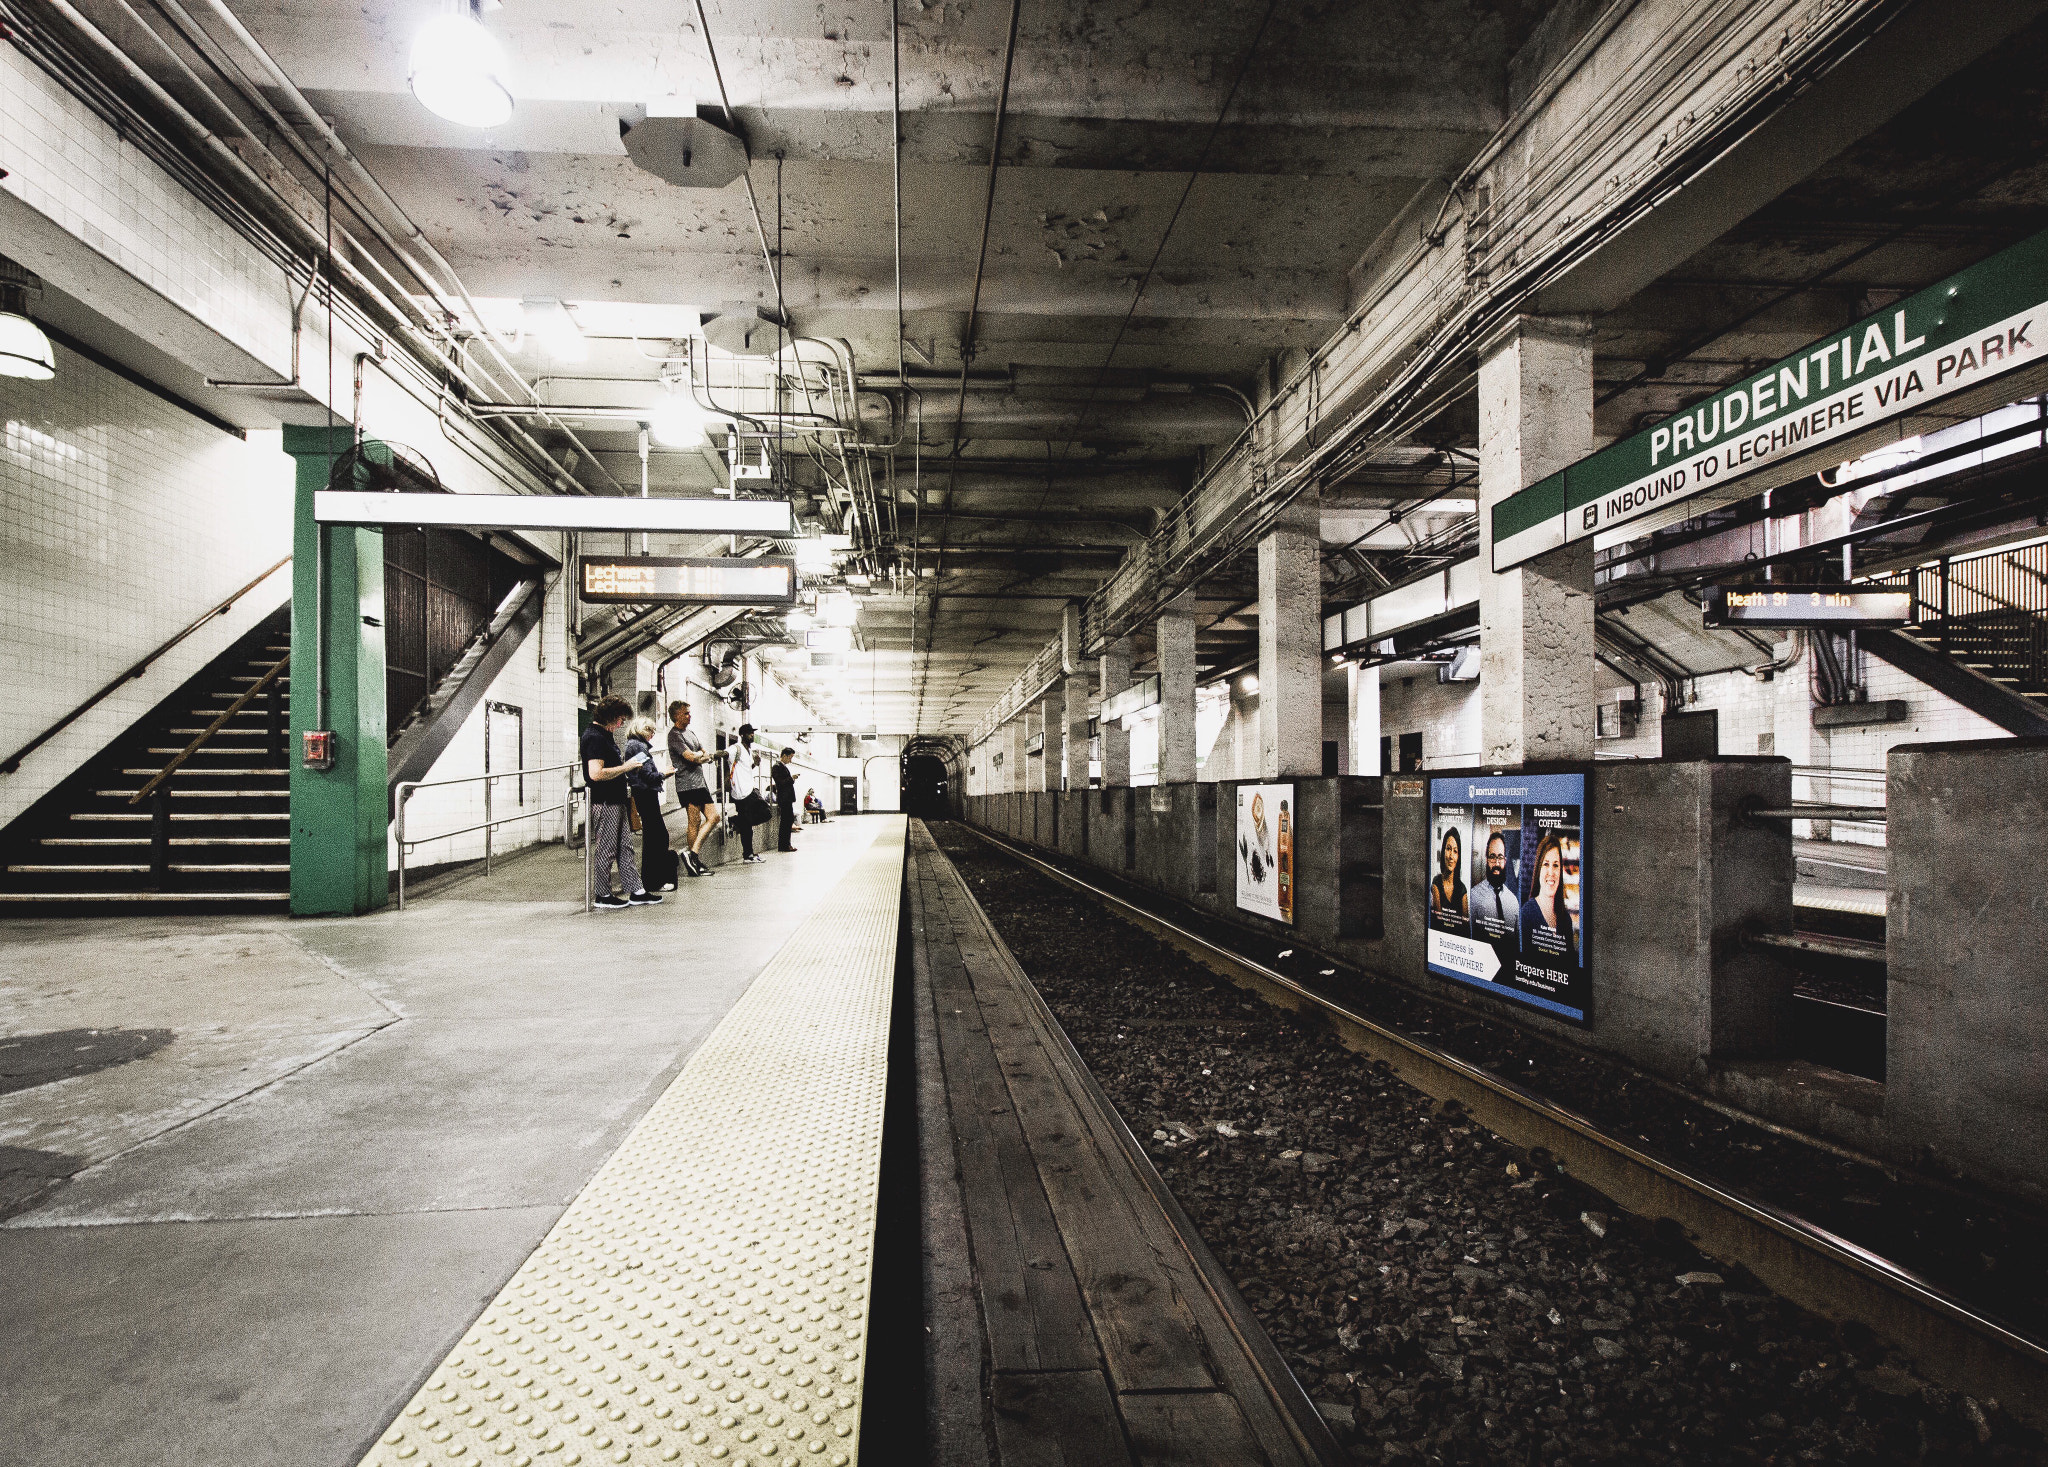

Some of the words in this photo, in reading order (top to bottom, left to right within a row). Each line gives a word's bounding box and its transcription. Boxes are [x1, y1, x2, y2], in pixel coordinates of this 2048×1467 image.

[1650, 309, 1925, 467] PRUDENTIAL
[1605, 467, 1687, 520] INBOUND
[1693, 458, 1719, 484] TO
[1726, 392, 1864, 469] LECHMERE
[1874, 370, 1924, 409] VIA
[1936, 319, 2035, 386] PARK
[585, 563, 655, 580] Lechmere
[585, 579, 655, 593] Lechmere
[1727, 591, 1767, 607] Heath
[1772, 592, 1787, 607] St
[1810, 592, 1820, 607] 3
[1825, 592, 1851, 607] min
[1475, 787, 1497, 797] BENTLEY
[1497, 787, 1528, 797] UNIVERSITY
[1438, 806, 1460, 815] Business
[1459, 806, 1465, 815] is
[1482, 807, 1505, 816] Business
[1506, 807, 1512, 816] is
[1533, 808, 1560, 818] Business
[1560, 808, 1567, 818] is
[1486, 817, 1507, 826] DESIGN
[1538, 819, 1562, 829] COFFEE
[1439, 937, 1467, 954] Business
[1467, 944, 1474, 955] is
[1439, 951, 1484, 973] EVERYWHERE
[1515, 960, 1545, 980] Prepare
[1546, 969, 1569, 986] HERE
[1515, 975, 1556, 993] bentley.edu/business
